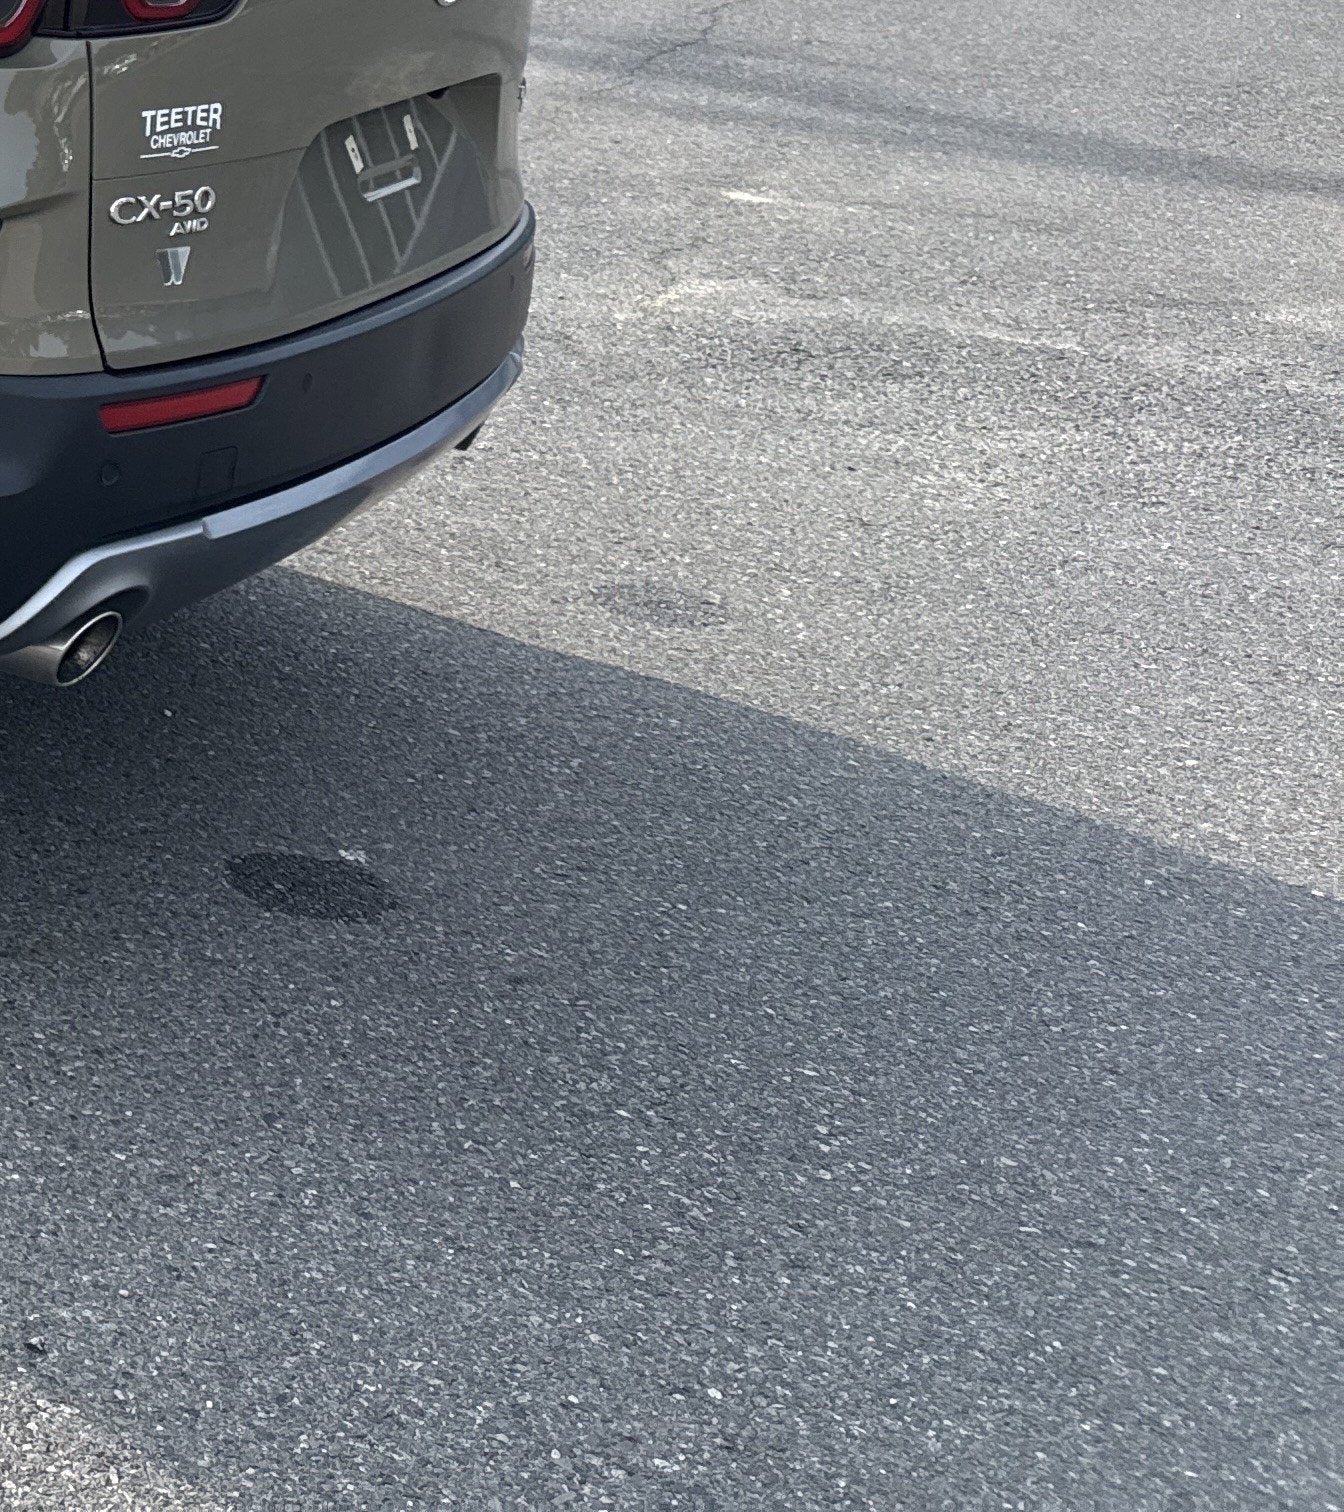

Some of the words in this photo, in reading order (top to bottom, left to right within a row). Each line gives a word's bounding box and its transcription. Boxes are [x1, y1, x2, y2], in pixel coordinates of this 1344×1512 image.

[141, 102, 222, 136] TEETER
[150, 128, 212, 150] CHEVROLET
[109, 186, 216, 225] CX-50
